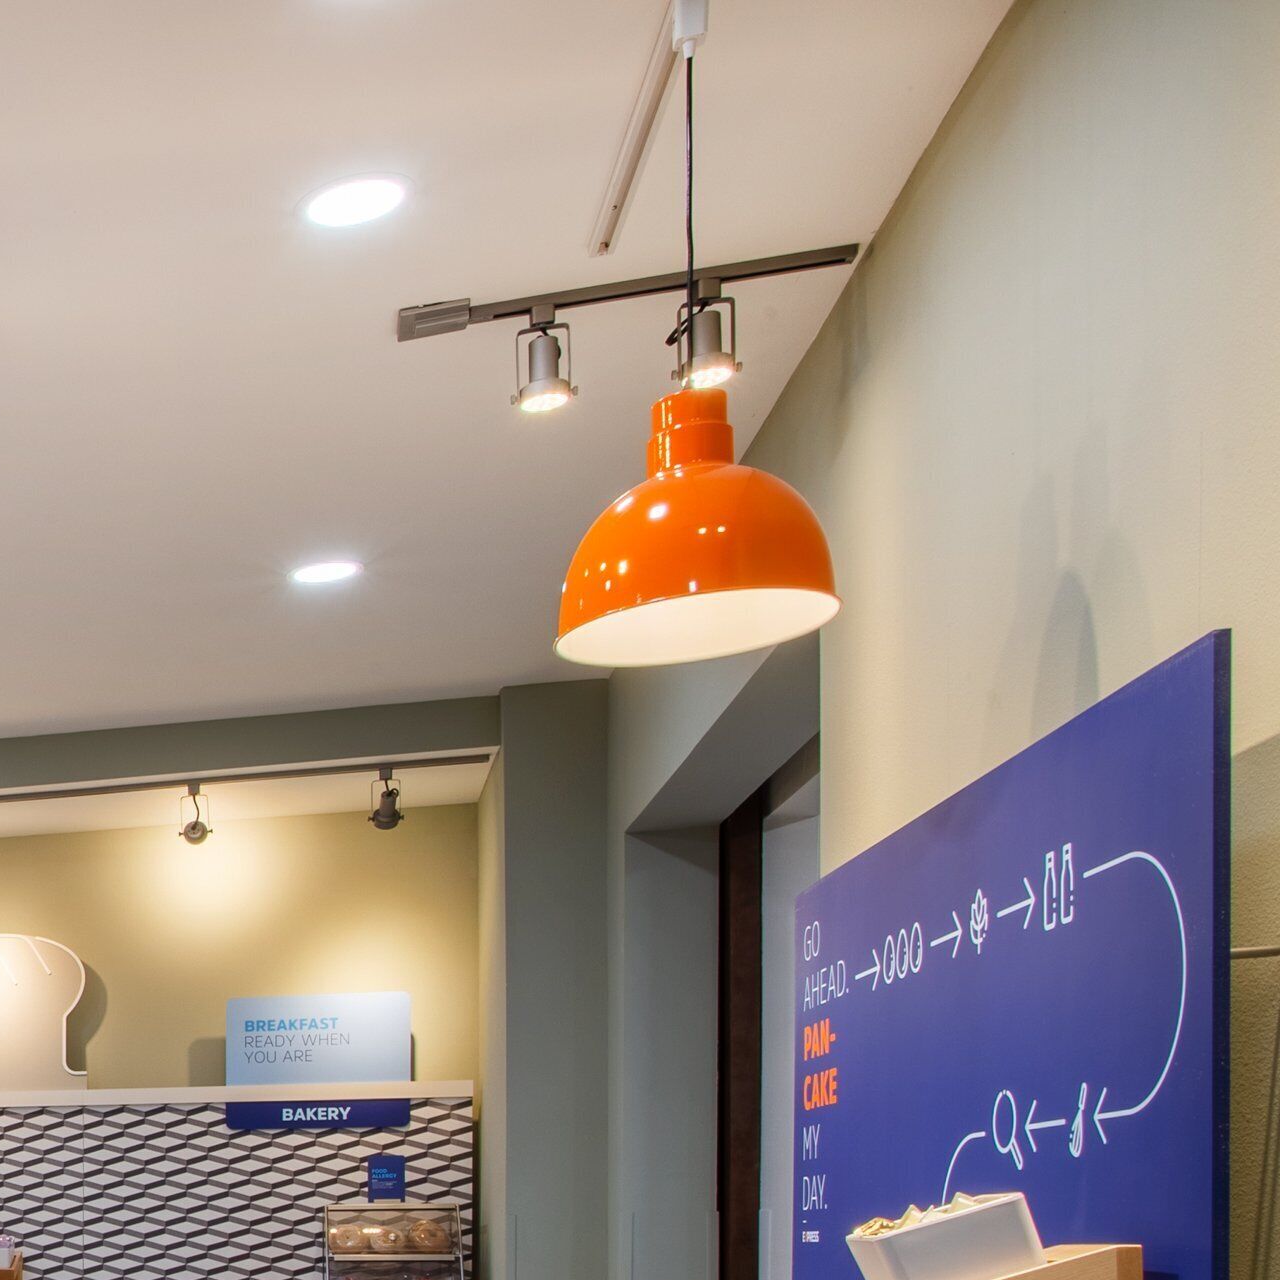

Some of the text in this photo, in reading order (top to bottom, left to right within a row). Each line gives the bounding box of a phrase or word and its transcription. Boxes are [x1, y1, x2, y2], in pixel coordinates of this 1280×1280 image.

[804, 921, 820, 961] GO
[804, 960, 849, 1012] AHEAD.
[244, 1017, 338, 1032] BREAKFAST
[244, 1032, 350, 1048] READY WHEN
[804, 1018, 836, 1061] PAN-
[244, 1049, 312, 1063] YOU ARE
[803, 1067, 838, 1110] CAKE
[282, 1107, 351, 1121] BAKERY
[803, 1124, 820, 1160] MY
[803, 1174, 828, 1211] DAY.
